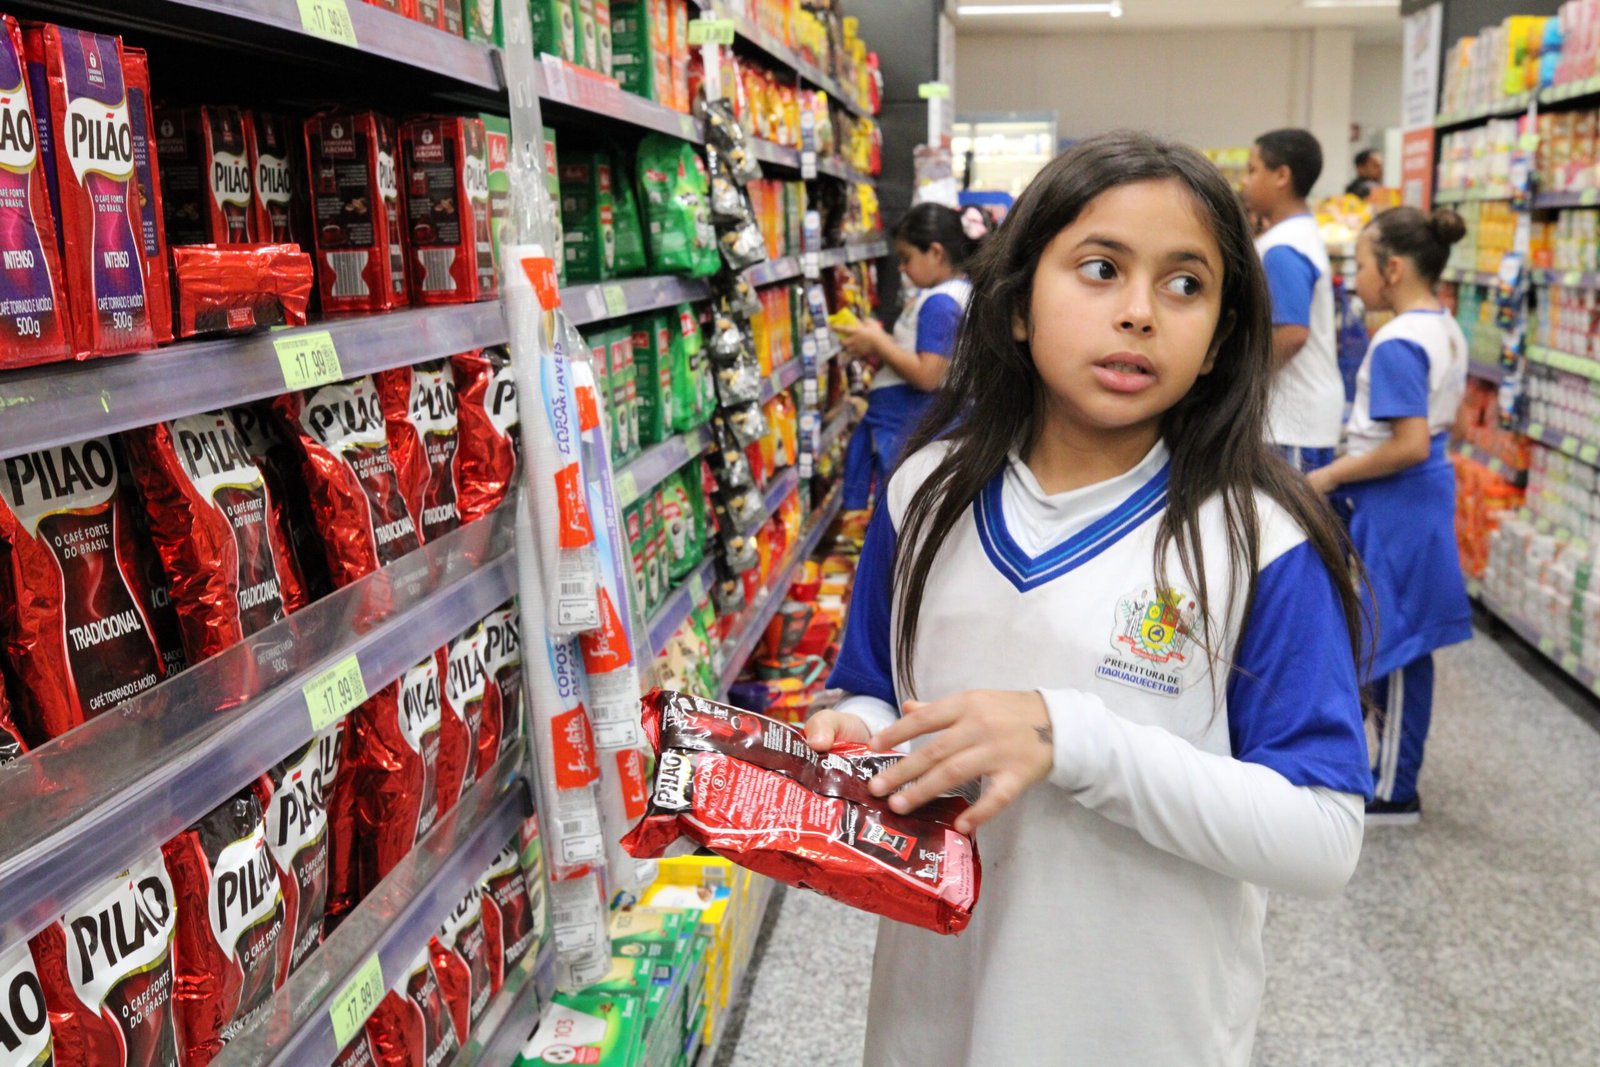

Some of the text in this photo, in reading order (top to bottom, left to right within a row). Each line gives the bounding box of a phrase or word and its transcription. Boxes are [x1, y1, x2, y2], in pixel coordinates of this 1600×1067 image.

[71, 112, 133, 163] PILÃO
[214, 160, 250, 194] PILÃO
[260, 162, 292, 194] PILÃO
[5, 199, 24, 208] BRASIL
[9, 188, 25, 198] FORTE
[95, 193, 124, 204] O CAFÉ FORTE
[98, 204, 122, 213] DO BRASIL
[3, 249, 35, 270] INTENSO
[104, 251, 130, 268] INTENSO
[10, 299, 32, 314] TORRADO
[32, 298, 37, 312] E
[36, 295, 53, 312] MOÍDO
[98, 298, 109, 311] CAFÉ
[109, 297, 127, 310] TORRADO
[130, 293, 144, 308] MOÍDO
[296, 350, 327, 382] 17,99
[309, 387, 384, 442] PILÃO
[178, 419, 257, 479] PILÃO
[353, 461, 359, 470] O
[360, 455, 376, 468] CAFÉ
[360, 464, 392, 479] DO BRASIL
[227, 498, 263, 517] O CAFÉ FORTE
[234, 512, 263, 528] DO BRASIL
[54, 523, 110, 548] O CAFÉ FORTE
[64, 537, 109, 560] DO BRASIL
[238, 578, 280, 611] TRADICIONAL
[69, 608, 142, 651] TRADICIONAL
[450, 641, 486, 700] PILÃ
[555, 644, 570, 698] COPOS
[1097, 665, 1180, 695] ITAQUAQUECETUBA
[1104, 657, 1180, 685] PREFEITURA DE
[89, 673, 157, 711] CAFÉ TORRADO E MOÍDO
[323, 676, 353, 715] 17,99
[715, 778, 725, 787] 8
[217, 837, 278, 933] PILÃO
[70, 875, 171, 985] PILÃO
[244, 920, 282, 963] O CAFÉ FORTE
[122, 970, 170, 1018] O CAFÉ FORTE
[130, 990, 169, 1029] DO BRASIL
[347, 981, 373, 1027] 17,99
[554, 1018, 574, 1039] 103
